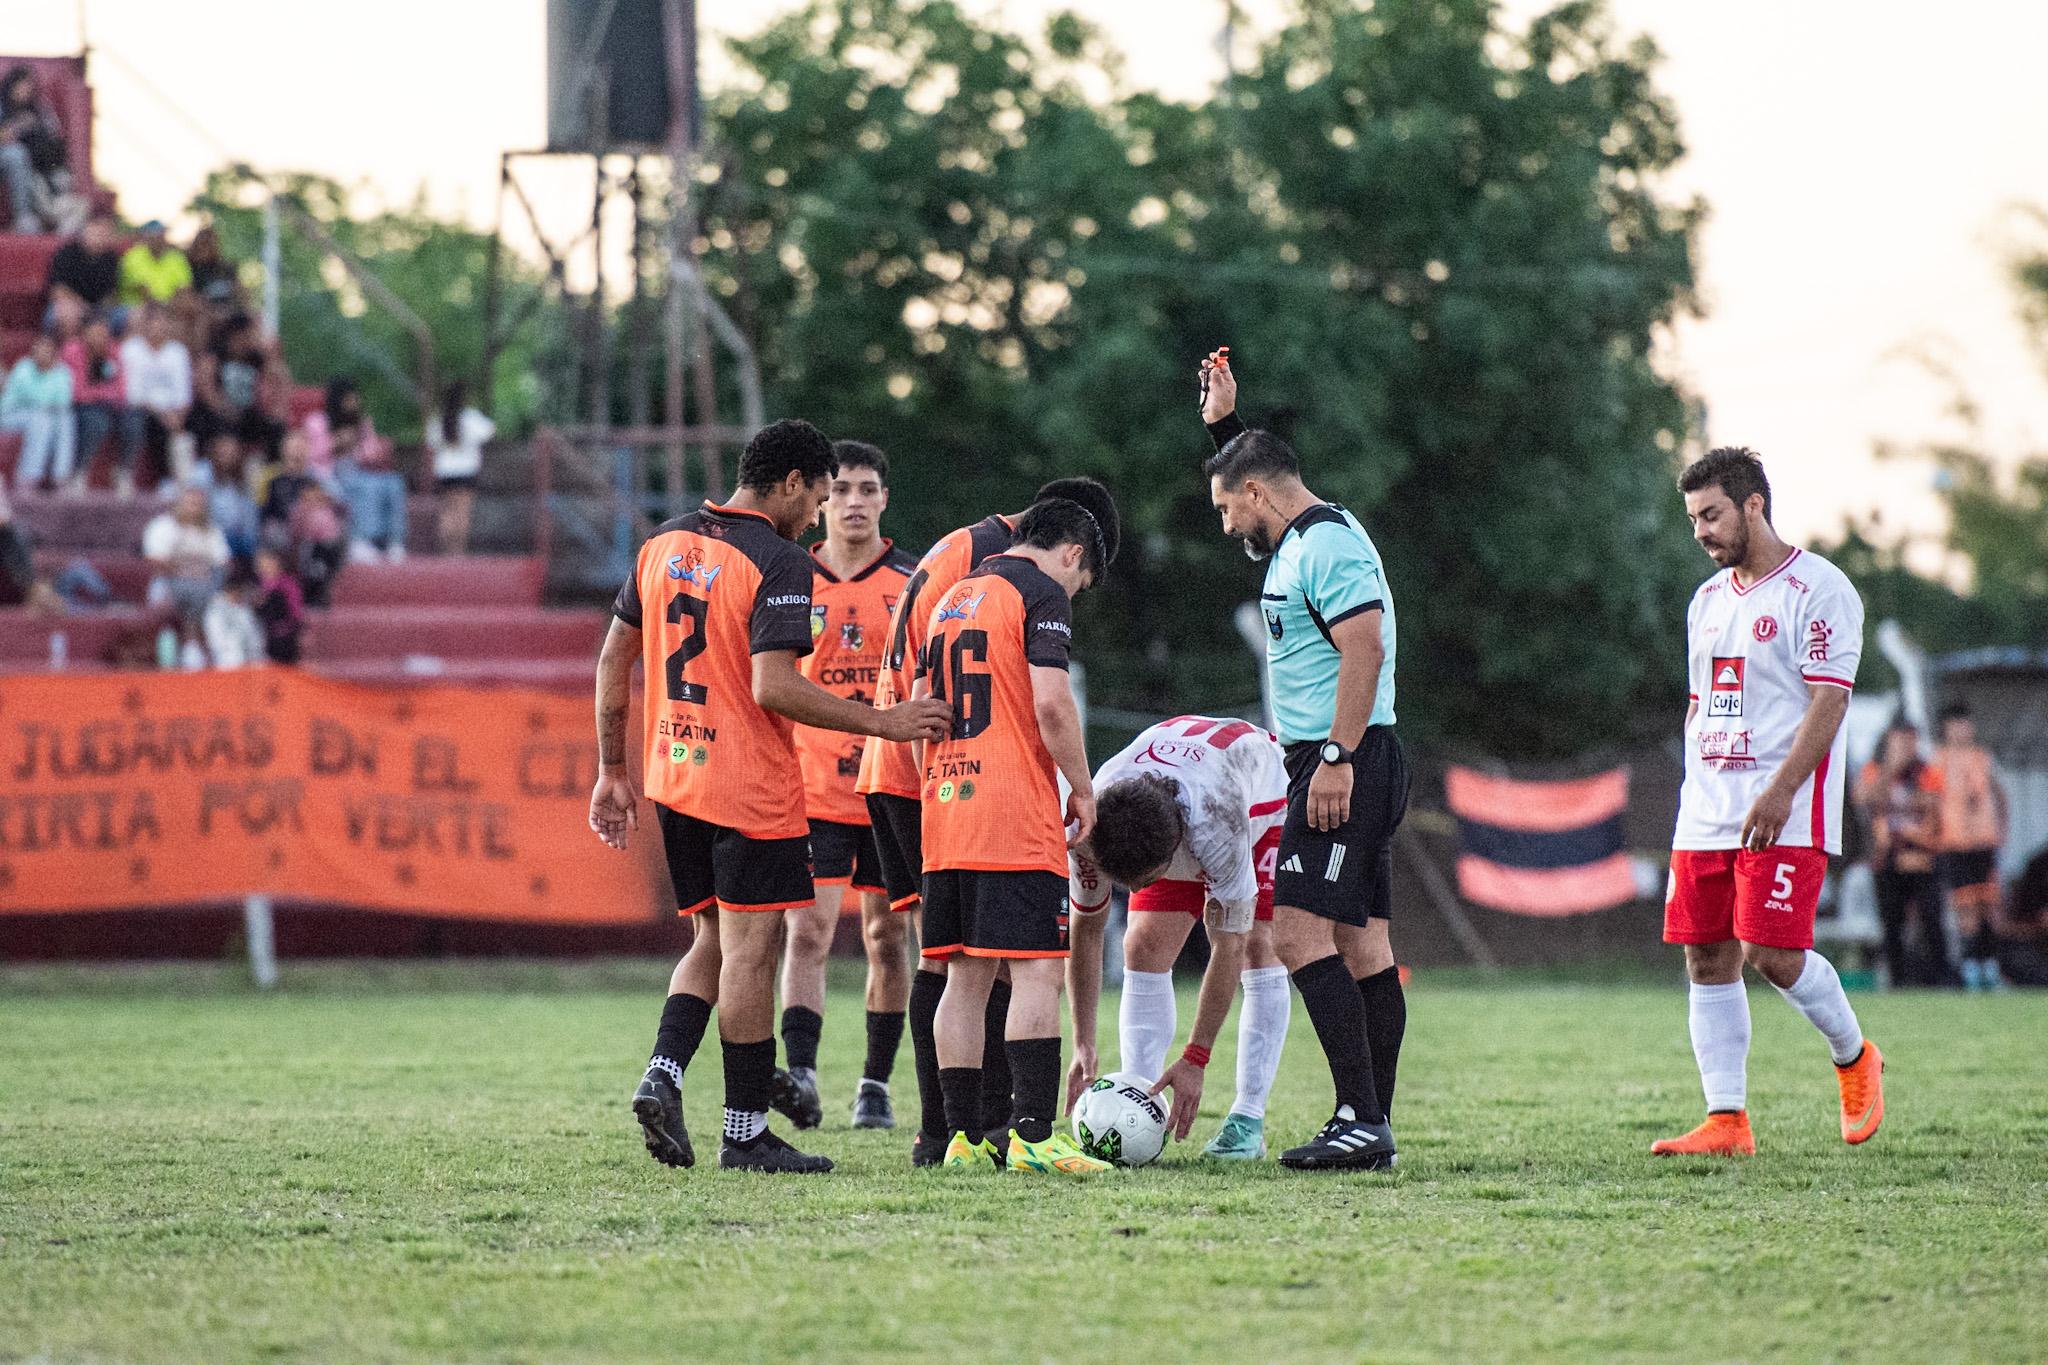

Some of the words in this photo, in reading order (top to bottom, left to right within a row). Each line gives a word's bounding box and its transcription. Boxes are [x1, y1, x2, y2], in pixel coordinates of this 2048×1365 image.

[1758, 619, 1772, 638] U
[665, 592, 709, 705] 2
[926, 629, 993, 741] 16
[672, 722, 717, 742] TATIN
[672, 747, 686, 757] 27
[517, 739, 600, 797] CI
[942, 760, 981, 778] TATIN
[941, 786, 952, 797] 27
[1770, 862, 1796, 900] 5
